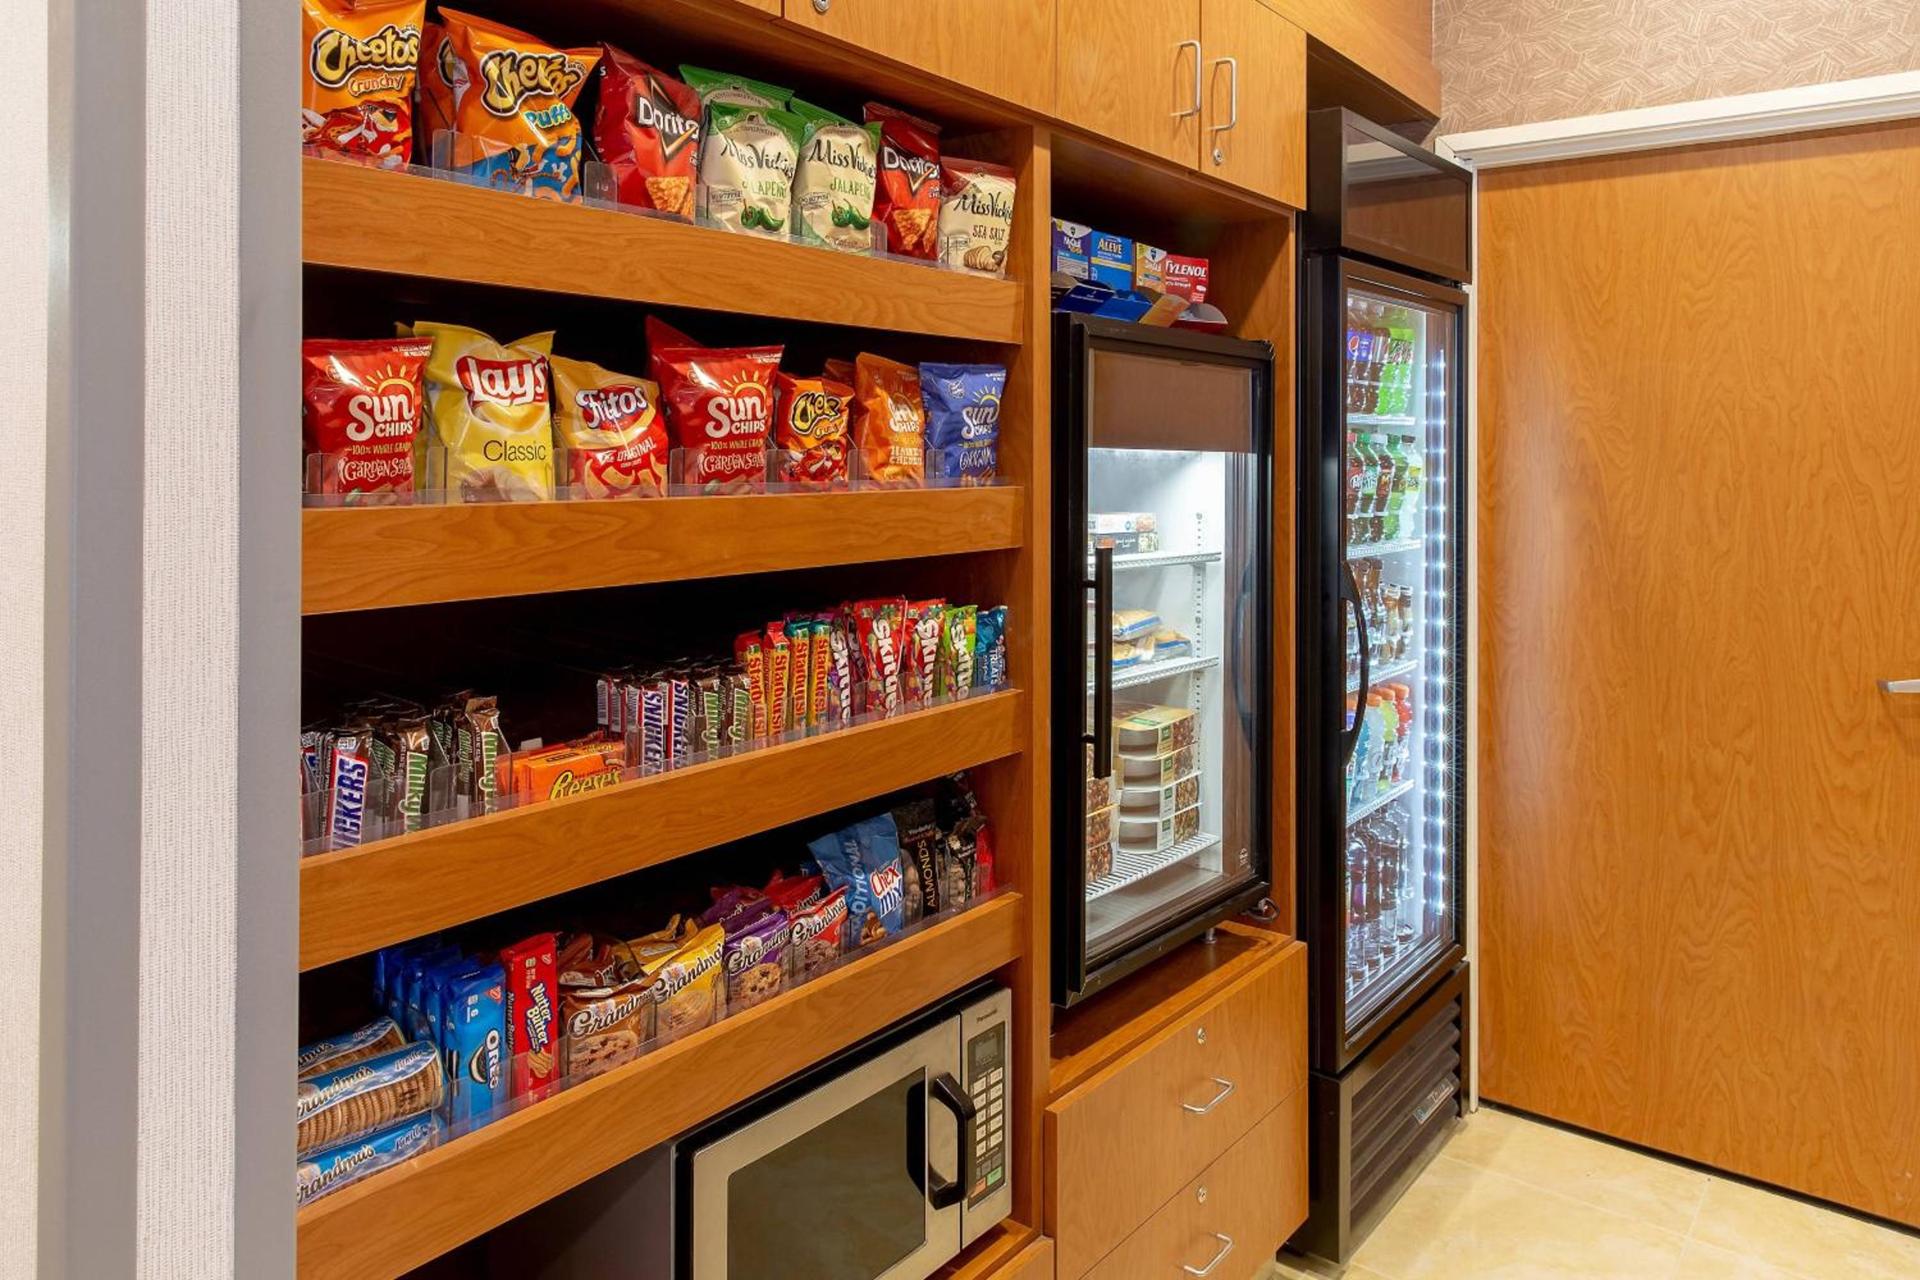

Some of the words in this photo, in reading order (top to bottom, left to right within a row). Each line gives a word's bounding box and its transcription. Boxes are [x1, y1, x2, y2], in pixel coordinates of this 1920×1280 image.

[313, 27, 419, 85] Cheetos
[348, 73, 404, 95] Crunchy
[482, 52, 580, 113] Chetos
[638, 96, 699, 139] Doritos
[808, 138, 849, 168] Miss
[884, 146, 939, 179] Doritos
[953, 193, 990, 215] Miss
[972, 224, 987, 239] SEA
[1098, 238, 1122, 254] ALEVE
[1166, 260, 1207, 277] TYLENOL
[468, 355, 549, 407] Lay's
[346, 391, 415, 441] Sun
[374, 421, 413, 438] CHIPS
[575, 386, 648, 428] Fritos
[705, 395, 768, 438] Sun
[731, 420, 766, 436] CHIPS
[961, 406, 1000, 440] Sun
[483, 440, 547, 462] Classic
[831, 629, 851, 724] Skittle
[914, 618, 939, 709] Skittle
[951, 624, 973, 700] Skittle
[643, 690, 662, 772] SNICKE
[673, 681, 688, 766] SNICKER
[399, 751, 428, 815] Milky
[843, 839, 868, 914] DITIONAL
[870, 858, 902, 897] Chex
[917, 839, 937, 908] ALMONDS
[792, 897, 847, 945] Grandma
[652, 942, 724, 1004] Grandma'
[724, 926, 791, 976] Grandm
[526, 1005, 549, 1045] Butter
[531, 982, 552, 1022] Nutter
[567, 988, 655, 1039] Grandm
[484, 1029, 500, 1090] OREO
[298, 1066, 375, 1117] randma's
[298, 1144, 375, 1201] randma's
